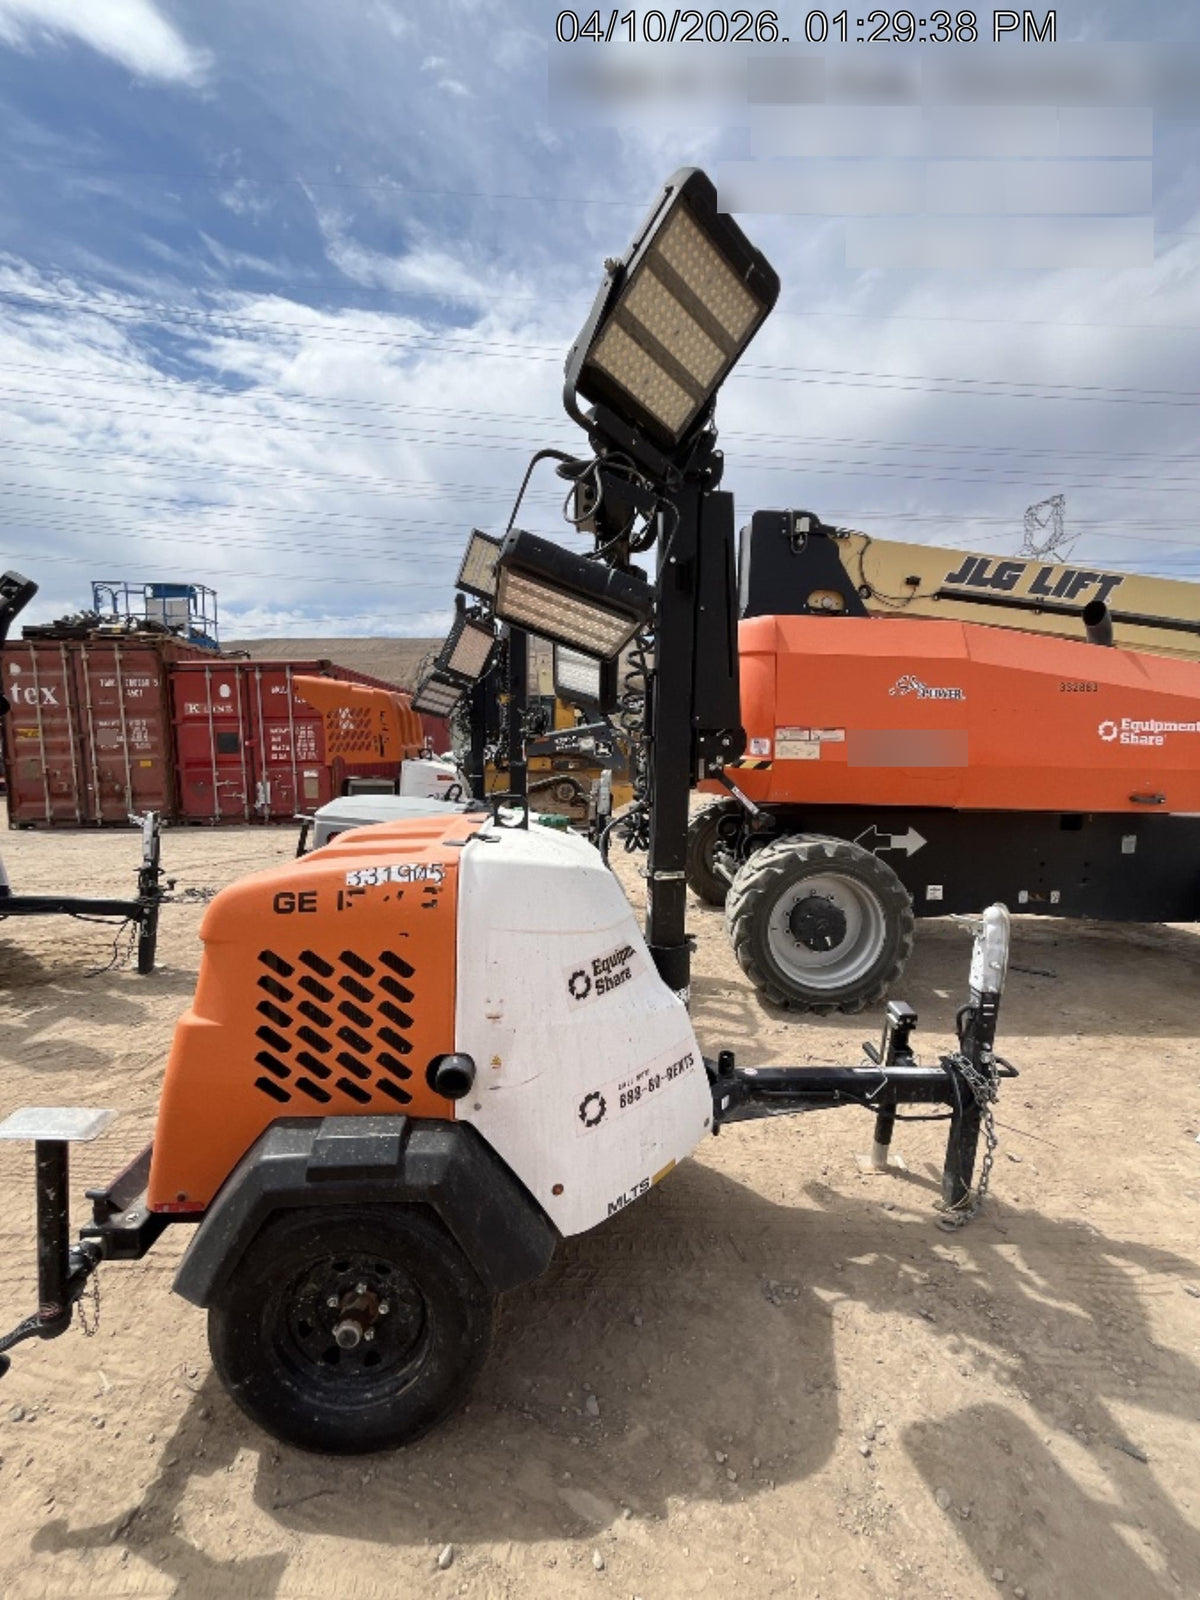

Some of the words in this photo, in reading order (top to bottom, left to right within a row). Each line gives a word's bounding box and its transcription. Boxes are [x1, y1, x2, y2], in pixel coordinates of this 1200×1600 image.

[944, 556, 1026, 590] JLG
[1028, 567, 1124, 603] LIFT
[10, 682, 58, 705] tex
[1121, 718, 1200, 733] Equipment
[1120, 733, 1164, 746] Share
[595, 967, 632, 996] Share
